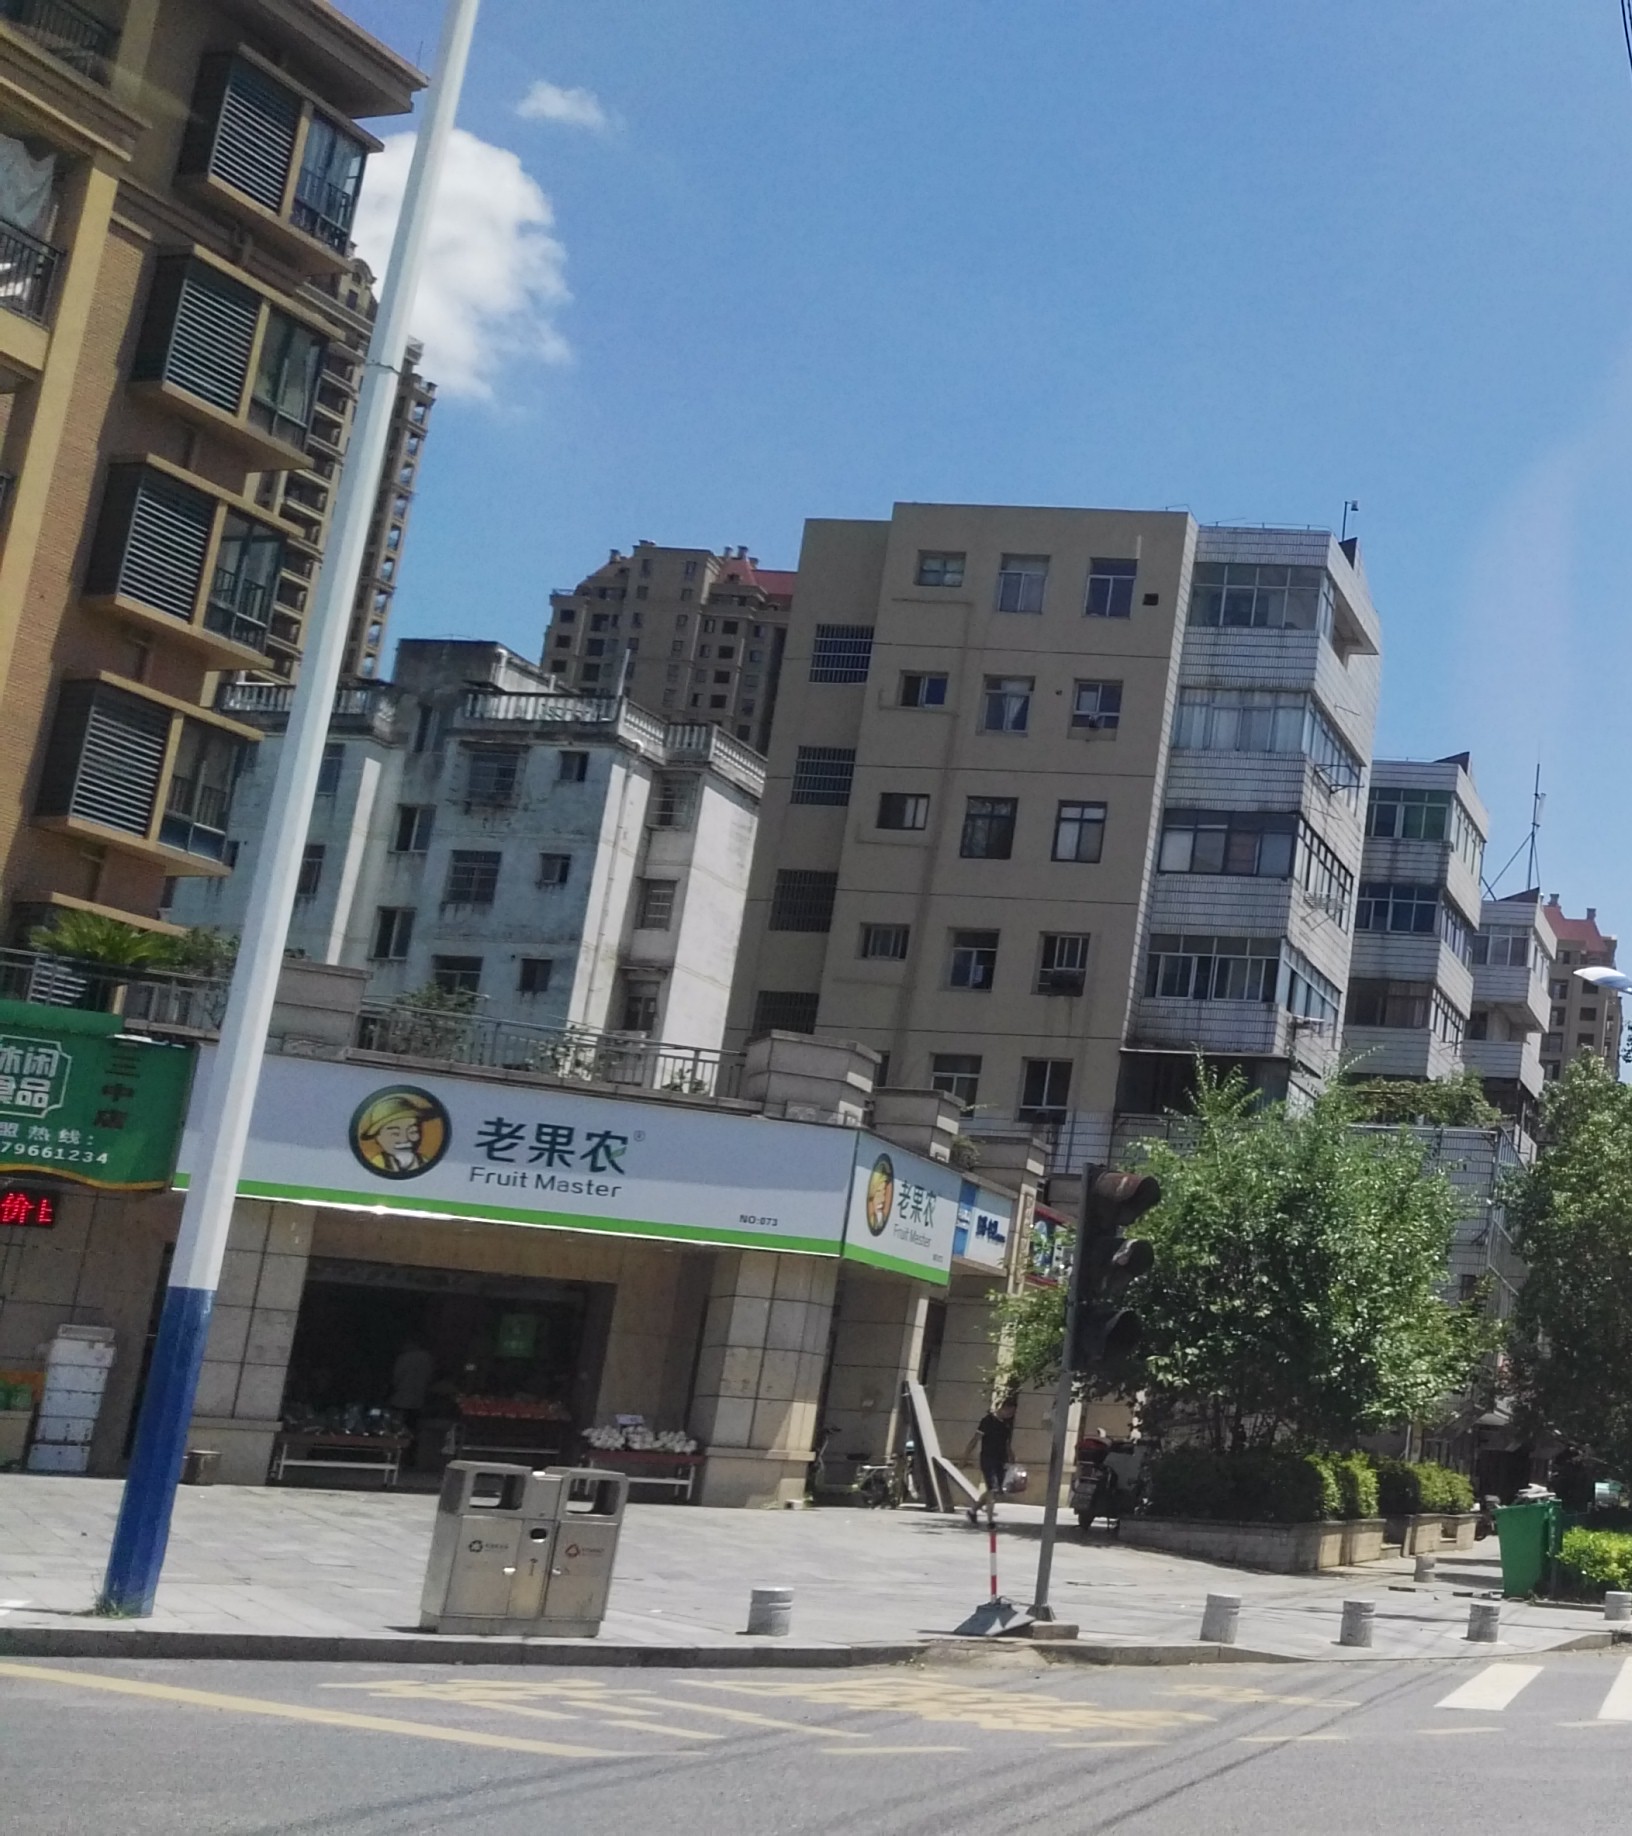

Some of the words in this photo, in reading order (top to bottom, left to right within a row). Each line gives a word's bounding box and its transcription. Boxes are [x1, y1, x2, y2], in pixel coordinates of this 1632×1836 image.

[474, 1117, 629, 1176] 老果农
[469, 1165, 529, 1189] Fruit
[534, 1173, 622, 1198] Master
[897, 1180, 937, 1229] 老果农
